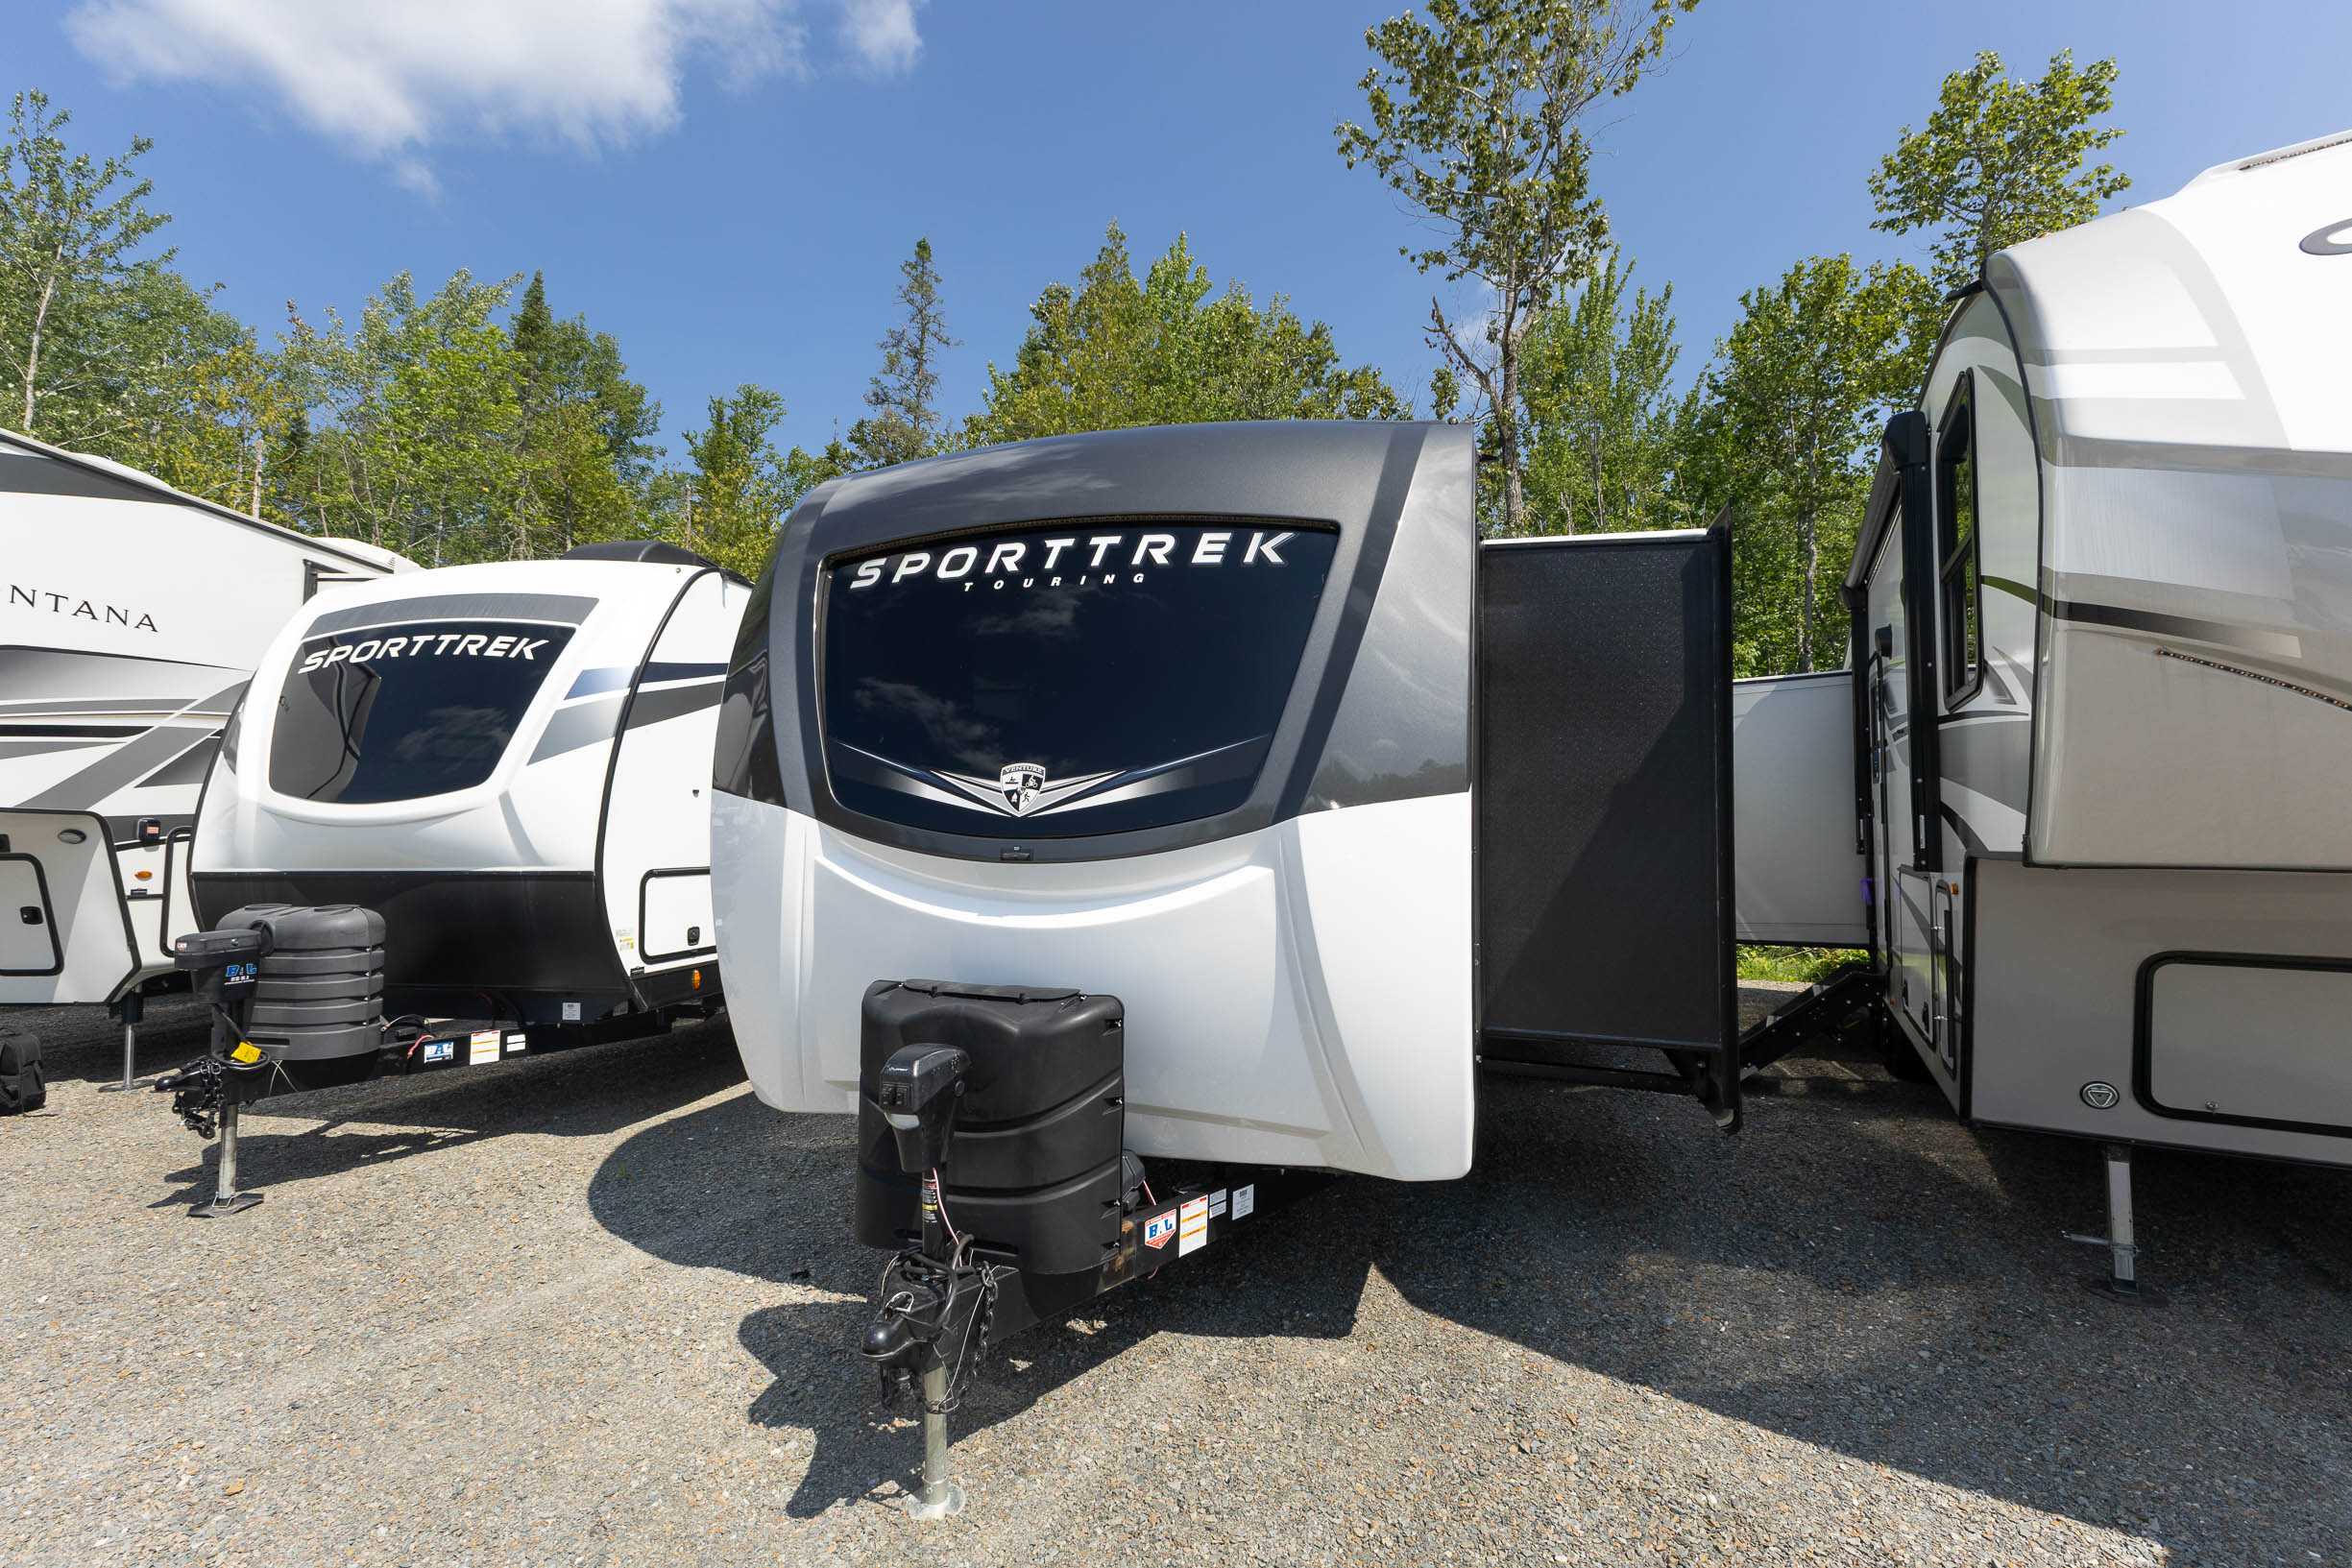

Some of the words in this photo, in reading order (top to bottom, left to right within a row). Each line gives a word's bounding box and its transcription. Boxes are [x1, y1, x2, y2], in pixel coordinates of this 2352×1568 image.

[850, 532, 1295, 589] SPORTTREK
[963, 573, 1145, 591] TOURING
[10, 584, 158, 633] NTANA
[298, 634, 549, 674] SPORTTREK
